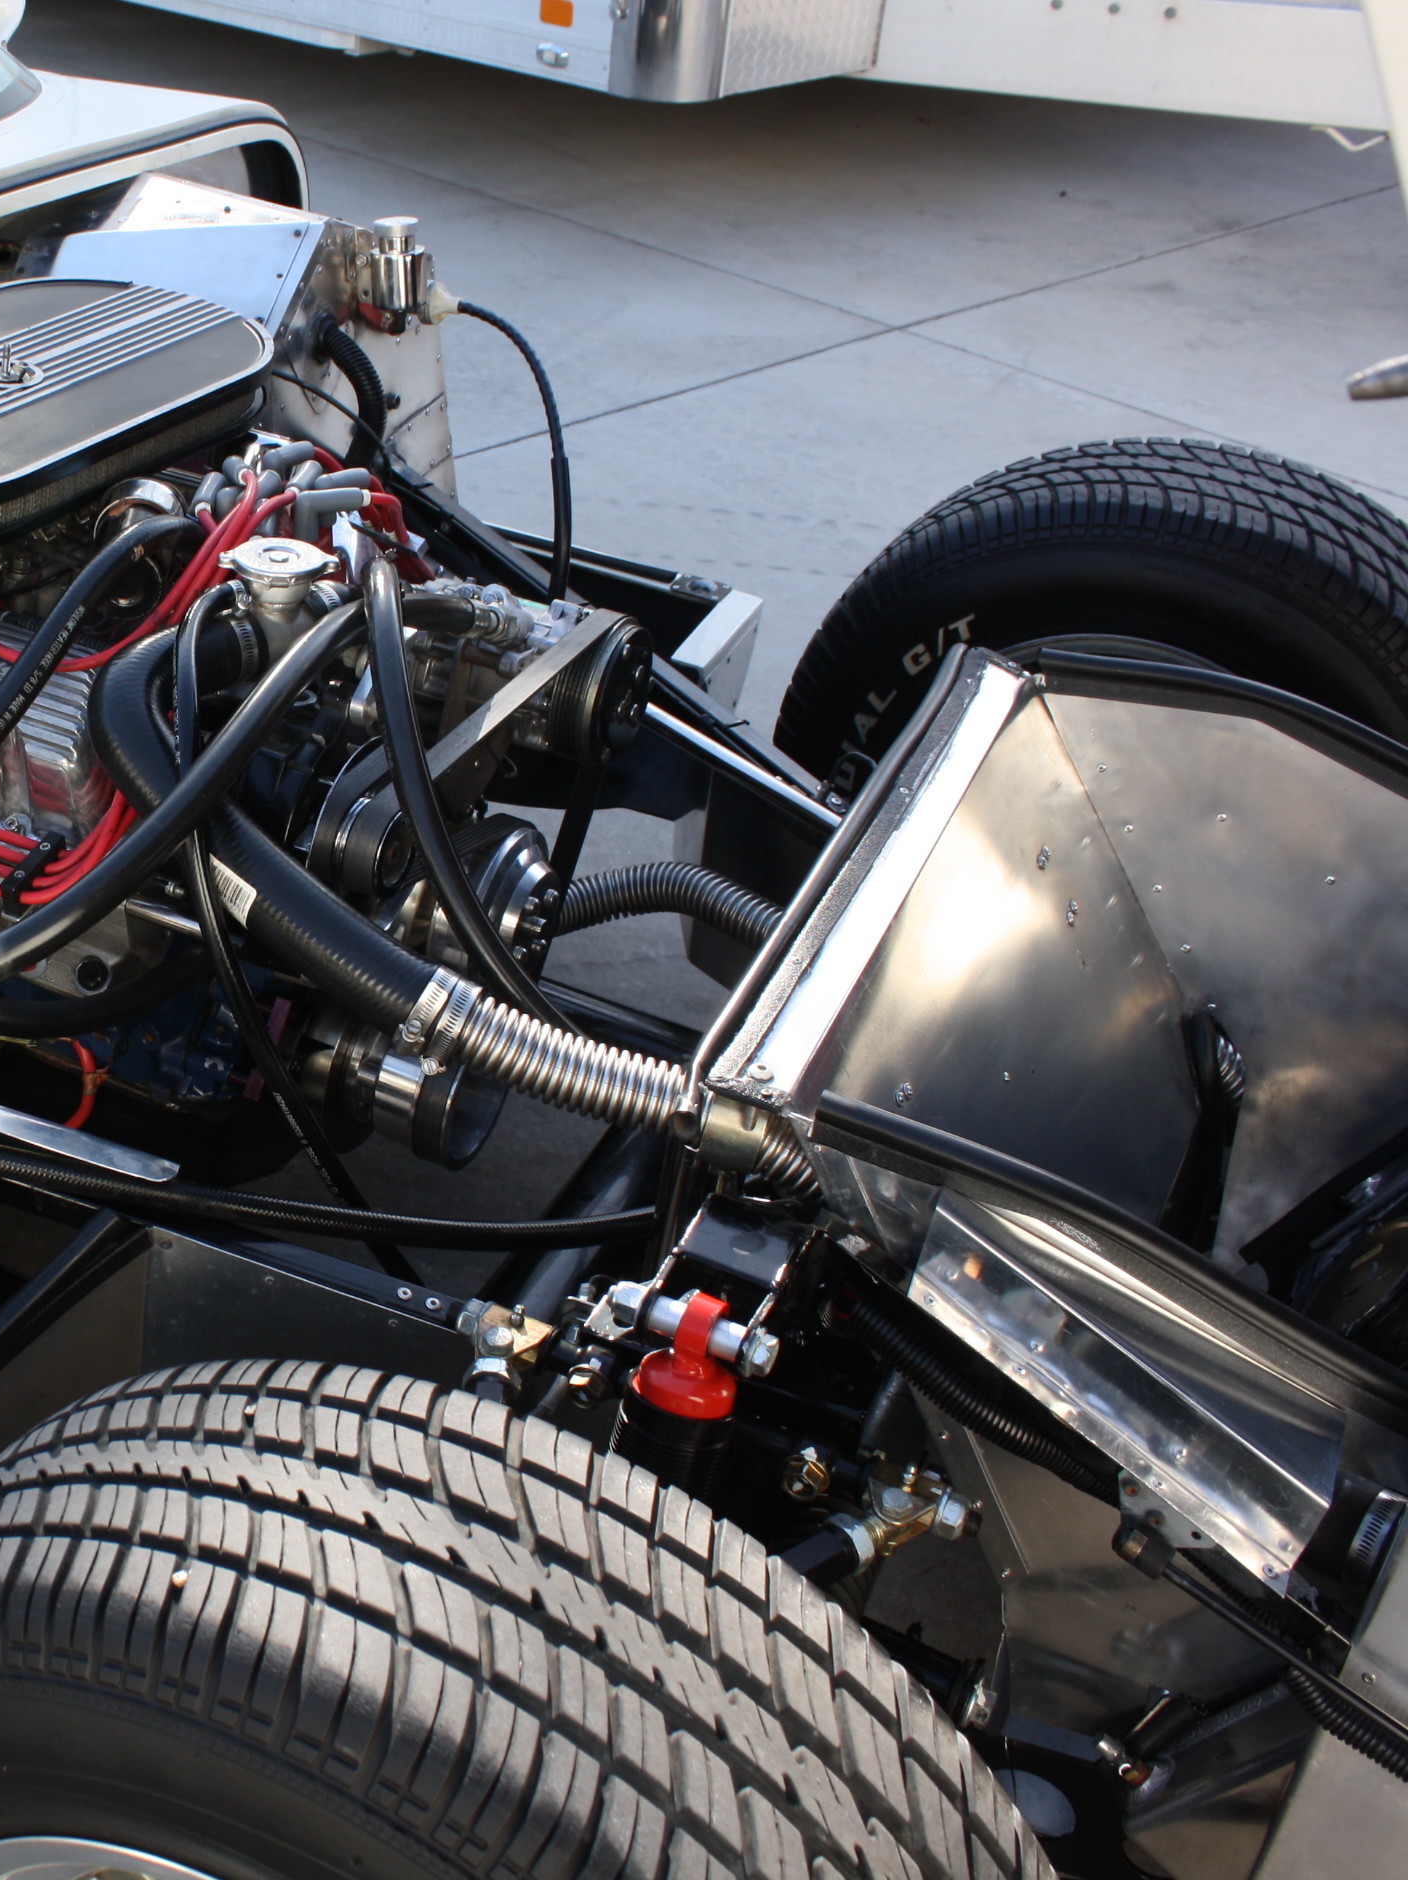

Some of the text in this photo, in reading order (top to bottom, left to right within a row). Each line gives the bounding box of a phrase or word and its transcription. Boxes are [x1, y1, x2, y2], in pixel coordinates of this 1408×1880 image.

[9, 694, 24, 711] MADE
[3, 712, 12, 720] IN
[305, 1147, 320, 1165] HOSE
[320, 1168, 332, 1184] FUEL
